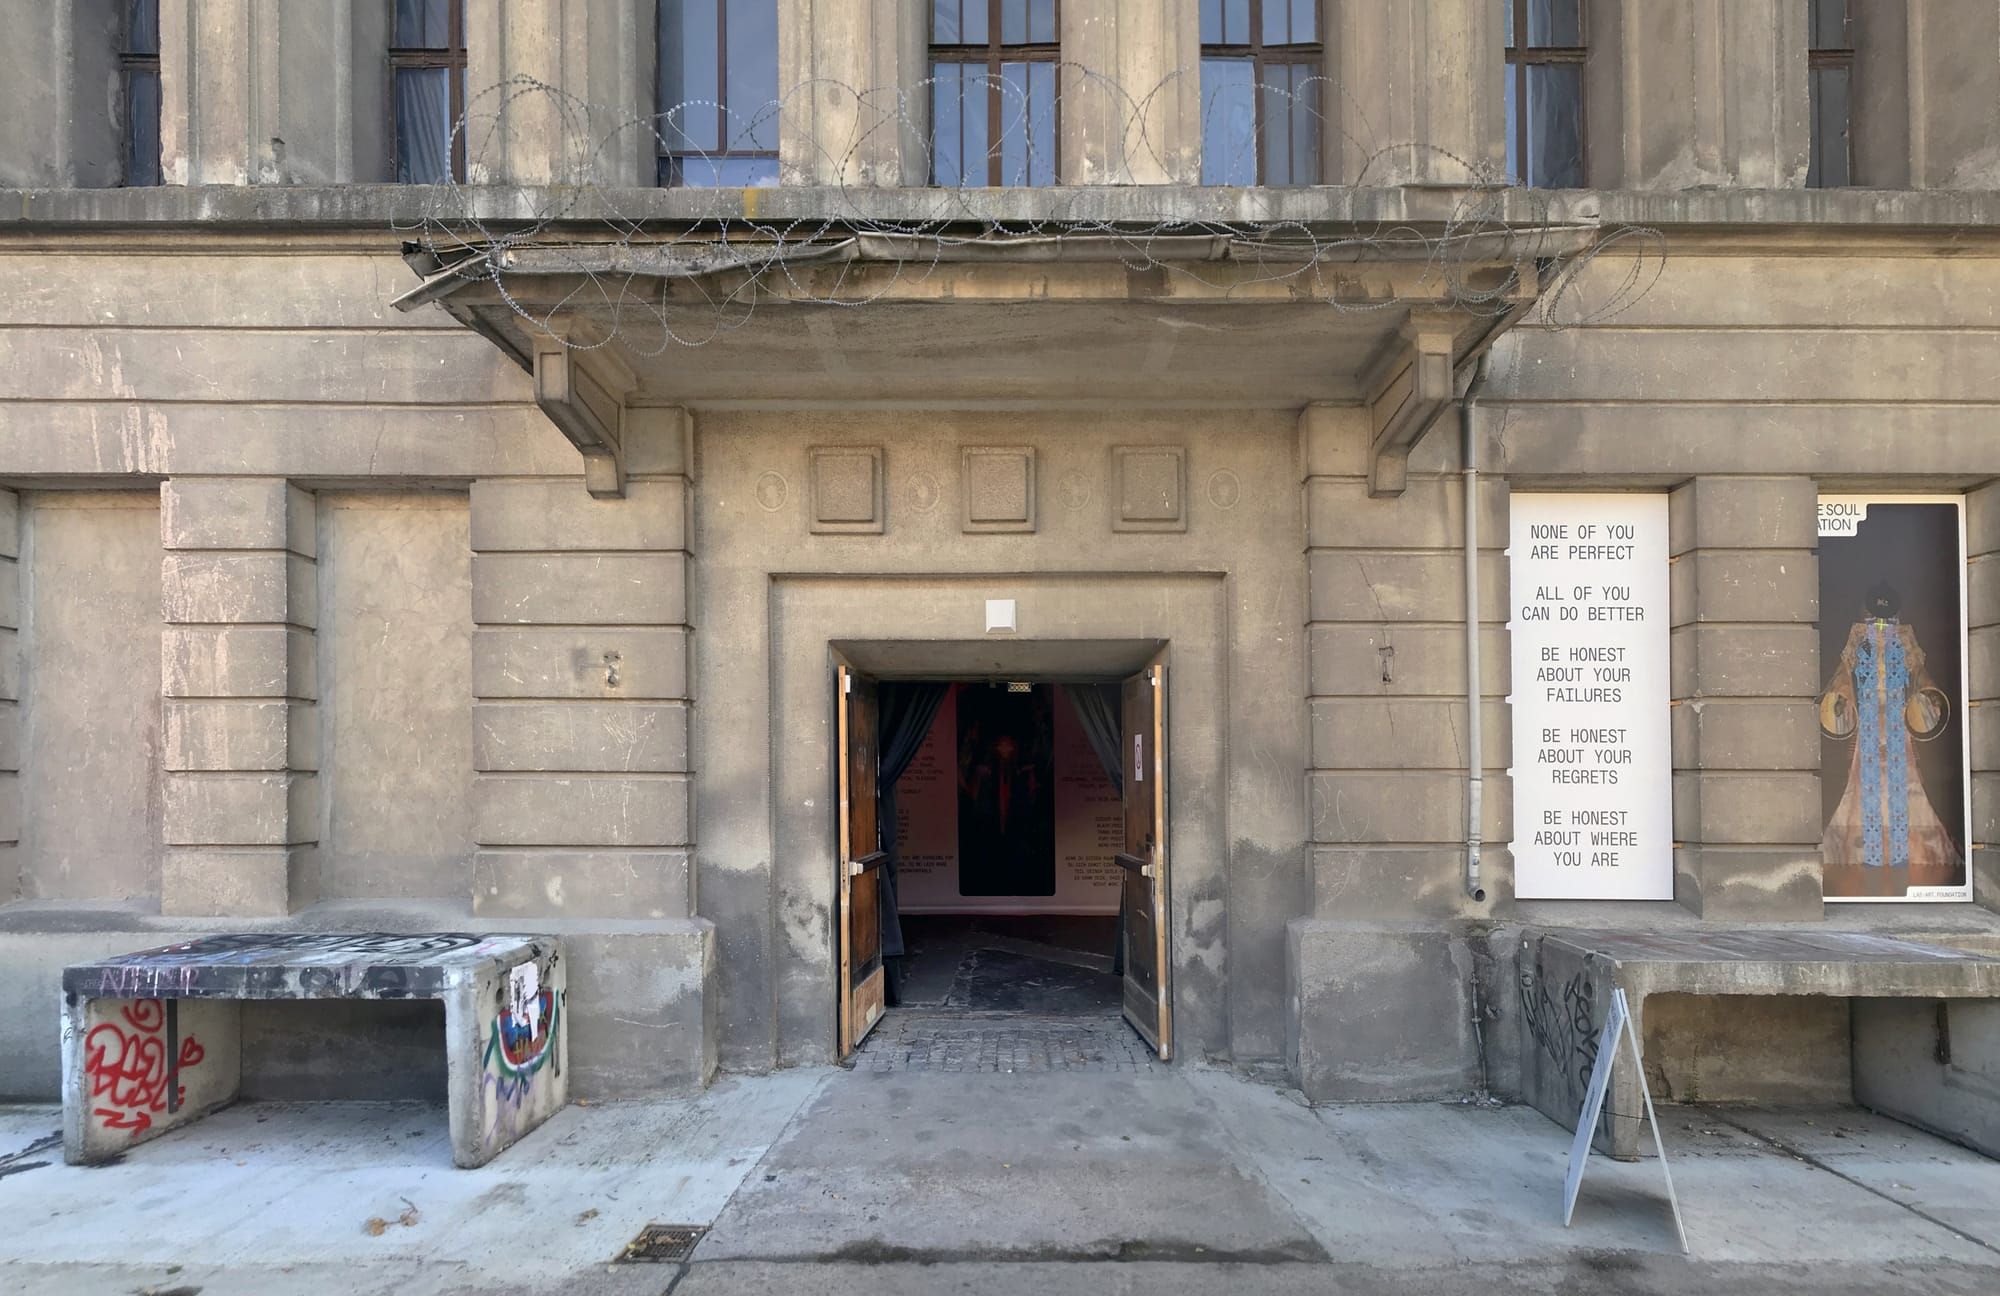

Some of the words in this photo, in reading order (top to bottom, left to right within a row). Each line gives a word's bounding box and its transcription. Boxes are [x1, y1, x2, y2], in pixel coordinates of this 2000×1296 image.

[1826, 503, 1860, 516] SOUL
[1531, 525, 1568, 539] NONE
[1578, 525, 1596, 539] OF
[1606, 525, 1634, 539] YOU
[1531, 545, 1558, 559] ARE
[1569, 545, 1634, 560] PERFECT
[1536, 586, 1564, 600] ALL
[1574, 586, 1592, 600] OF
[1602, 586, 1629, 601] YOU
[1522, 606, 1549, 620] CAN
[1560, 607, 1578, 621] DO
[1588, 607, 1644, 621] BETTER
[1542, 647, 1559, 661] BE
[1570, 647, 1625, 662] HONEST
[1537, 667, 1583, 682] ABOUT
[1593, 668, 1630, 682] YOUR
[1547, 688, 1621, 702] FAILURES
[1543, 728, 1560, 742] BE
[1571, 729, 1627, 743] HONEST
[1538, 749, 1584, 763] ABOUT
[1595, 749, 1631, 764] YOUR
[1553, 770, 1618, 784] REGRETS
[1544, 811, 1562, 824] BE
[1572, 811, 1628, 825] HONEST
[1534, 831, 1581, 846] ABOUT
[1591, 832, 1637, 846] WHERE
[1554, 852, 1581, 866] YOU
[1591, 852, 1619, 866] ARE
